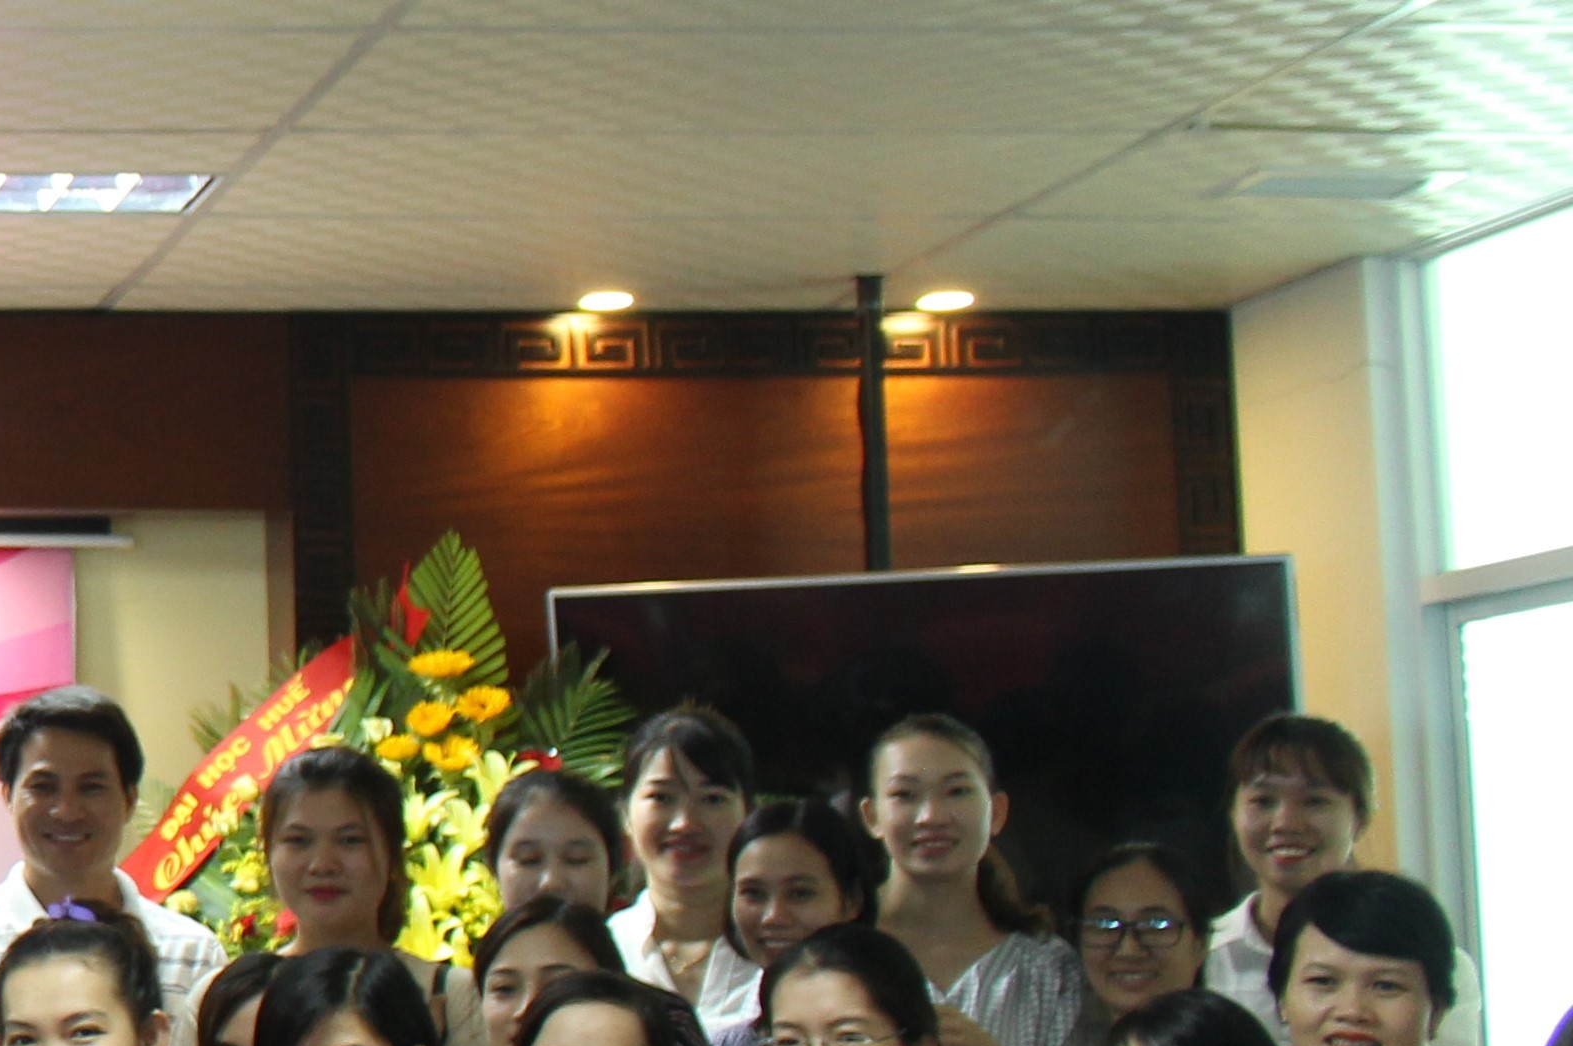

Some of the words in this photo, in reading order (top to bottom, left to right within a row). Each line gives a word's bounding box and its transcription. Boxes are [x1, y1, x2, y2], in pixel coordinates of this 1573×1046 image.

[159, 790, 199, 843] ĐẠI
[196, 734, 253, 790] HỌC
[255, 672, 312, 732] HUẾ
